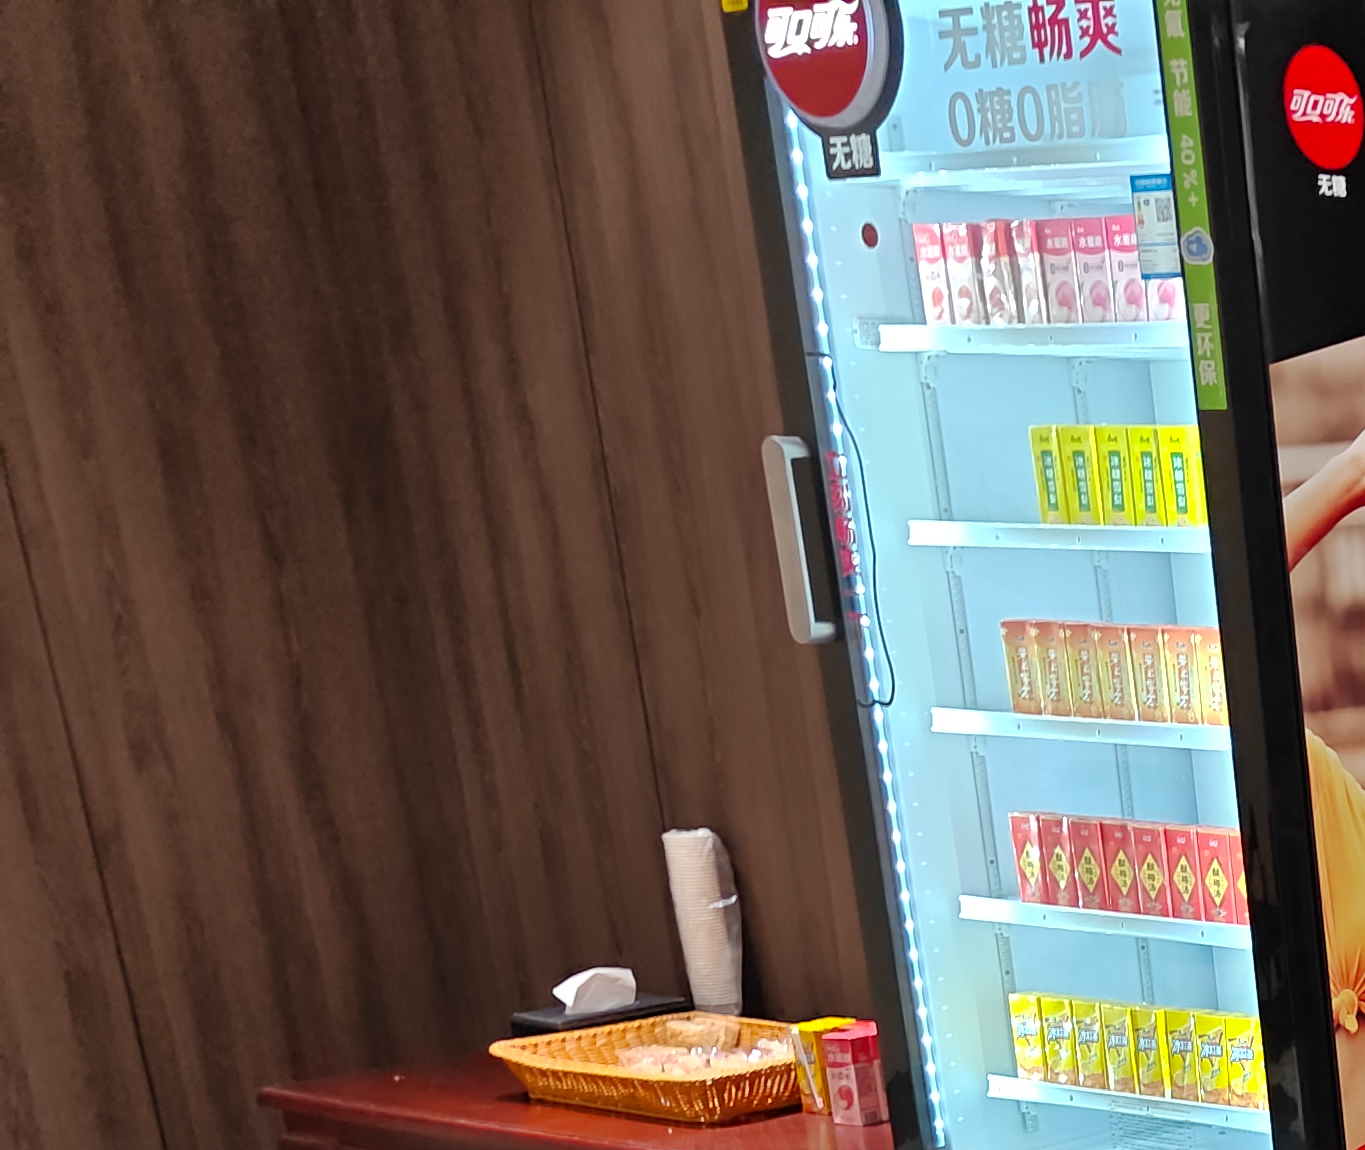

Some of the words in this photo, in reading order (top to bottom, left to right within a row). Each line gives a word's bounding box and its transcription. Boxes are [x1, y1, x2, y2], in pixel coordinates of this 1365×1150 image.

[948, 81, 1127, 149] 0糖0脂肪
[1289, 88, 1358, 125] 可口可乐
[828, 134, 876, 172] 无糖
[1317, 173, 1348, 198] 无糖
[1169, 58, 1193, 117] 节能
[1193, 303, 1218, 386] 更环保
